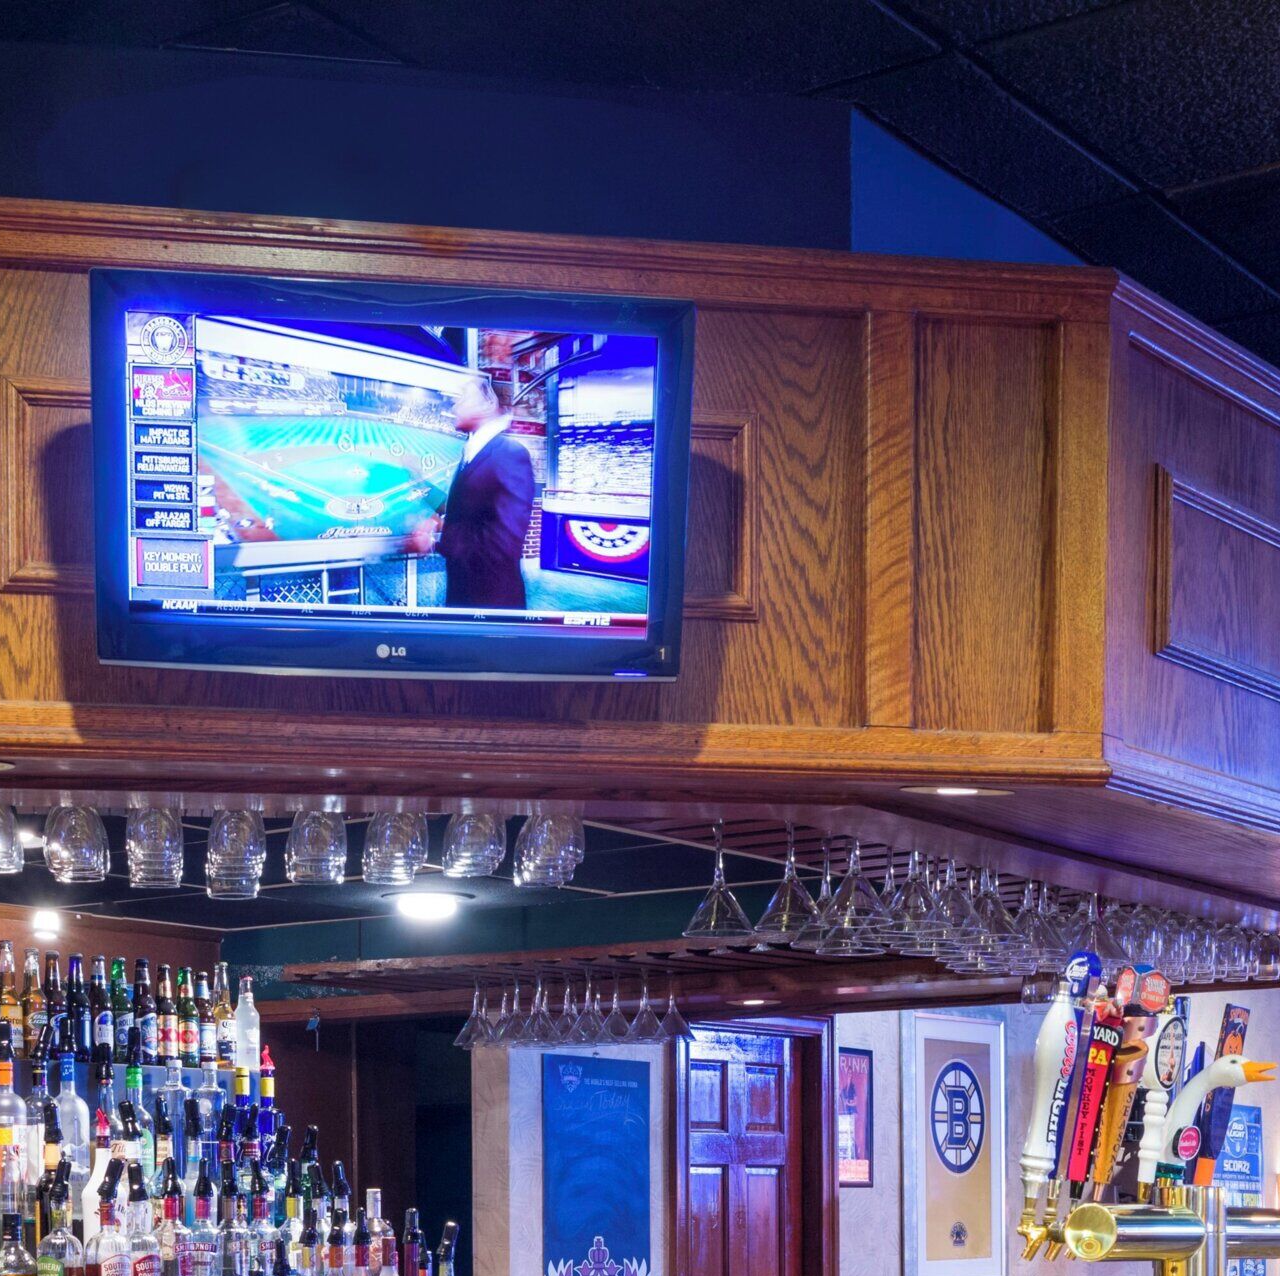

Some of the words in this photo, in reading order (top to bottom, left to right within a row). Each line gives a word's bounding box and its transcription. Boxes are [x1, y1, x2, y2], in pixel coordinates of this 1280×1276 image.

[149, 428, 178, 437] IMPACT
[180, 429, 190, 437] OF
[140, 436, 161, 445] MATT
[162, 437, 190, 446] ADAMS
[153, 491, 165, 500] PIT
[176, 492, 190, 501] STL
[154, 511, 190, 520] SALAZAR
[145, 519, 160, 528] OFF
[161, 519, 191, 529] TARGET
[143, 551, 160, 561] KEY
[161, 552, 202, 563] MOMENT:
[145, 563, 179, 573] DOUBLE
[180, 563, 203, 574] PLAY
[391, 646, 407, 657] LG
[1093, 1026, 1119, 1047] YARD
[1060, 1020, 1078, 1078] Coors
[840, 1056, 868, 1073] RINK
[1081, 1068, 1096, 1119] MONKEY
[1047, 1078, 1069, 1143] LIGHT
[946, 1086, 972, 1149] B
[1232, 1123, 1245, 1131] BUD
[1076, 1122, 1087, 1155] FIST
[1230, 1130, 1246, 1138] LIGHT
